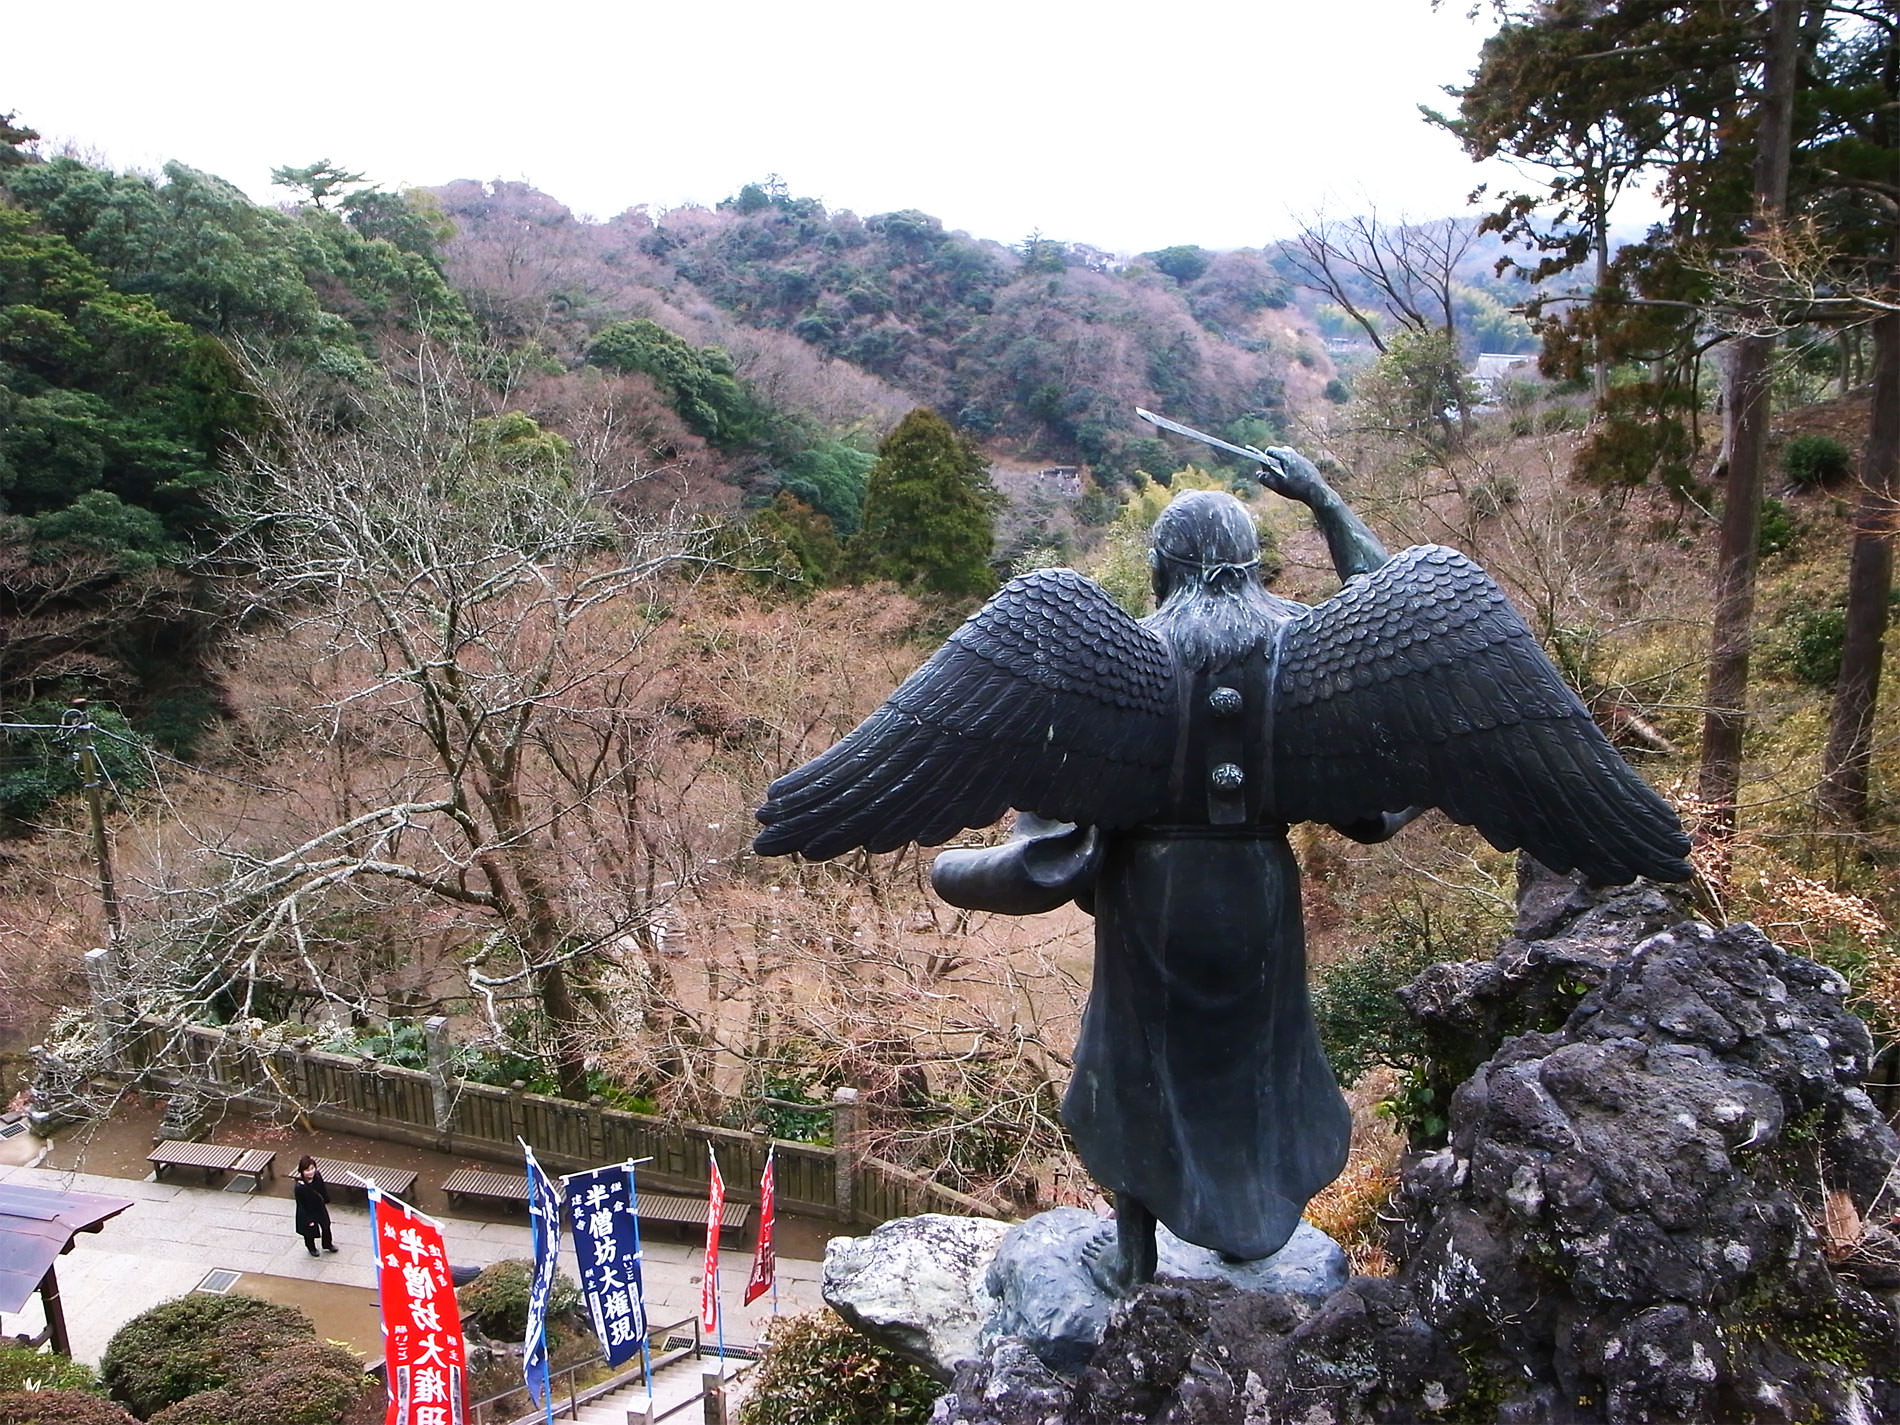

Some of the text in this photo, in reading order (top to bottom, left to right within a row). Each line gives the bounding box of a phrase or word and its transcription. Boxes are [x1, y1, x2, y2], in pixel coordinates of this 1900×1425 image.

[584, 1184, 636, 1347] 半僧坊大権現
